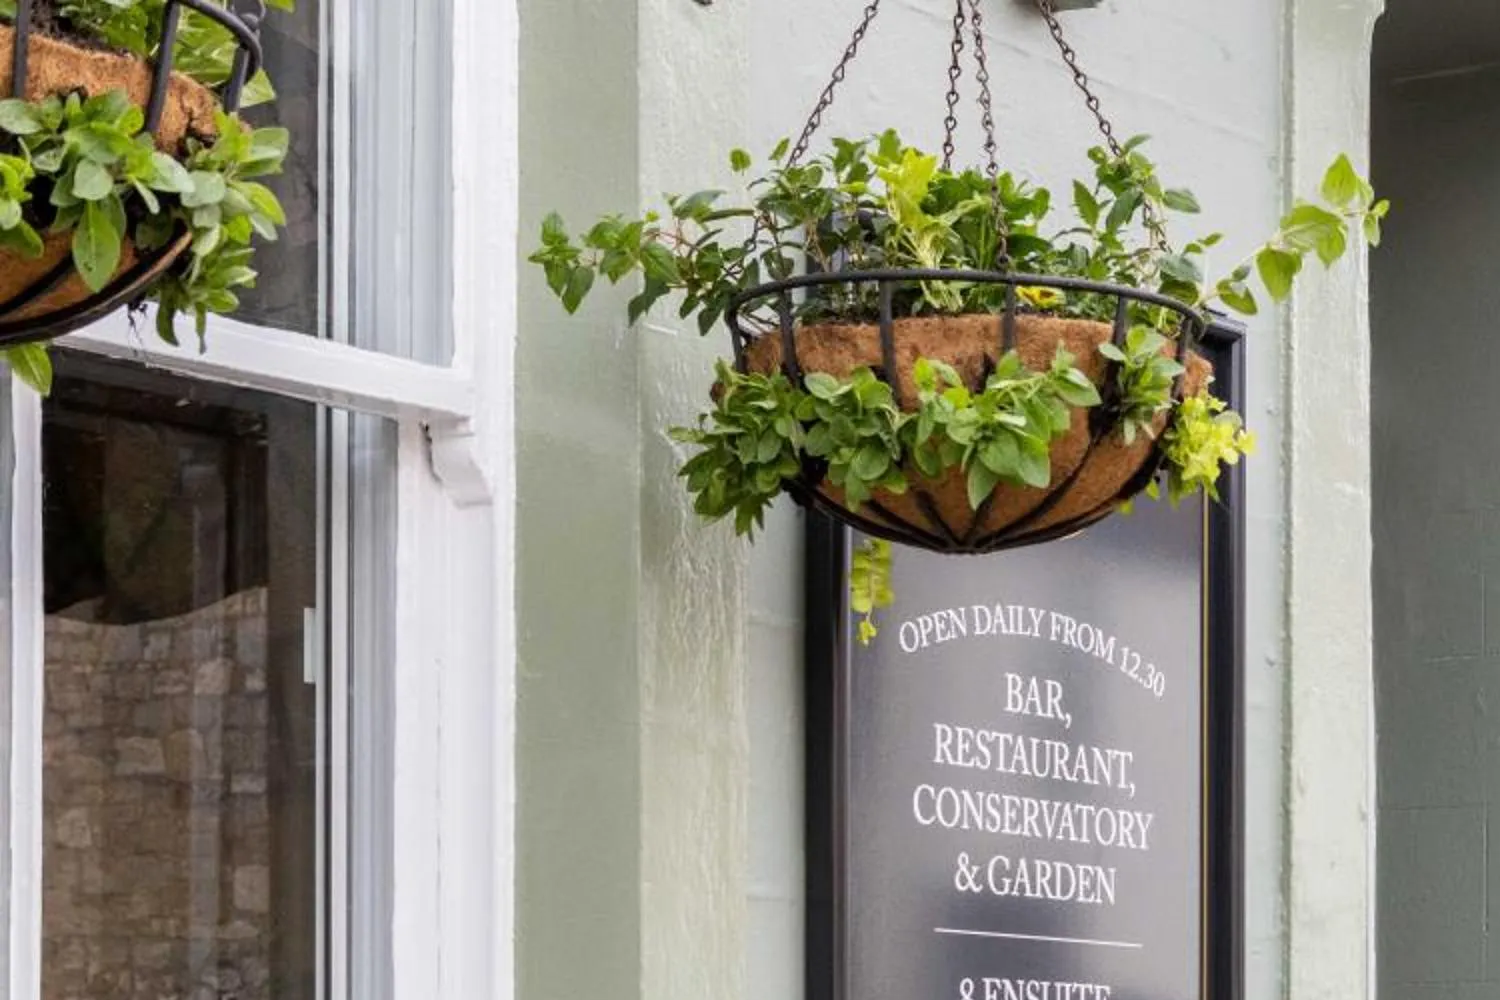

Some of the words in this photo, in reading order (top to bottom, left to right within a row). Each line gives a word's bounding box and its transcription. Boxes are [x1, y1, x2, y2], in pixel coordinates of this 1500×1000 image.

[900, 607, 968, 653] OPEN
[973, 603, 1046, 638] DAILY
[1049, 611, 1117, 666] FROM
[1119, 646, 1166, 698] 12.30
[1004, 672, 1072, 728] BAR,
[933, 722, 1136, 798] RESTAURANT,
[912, 784, 1154, 851] CONSERVATORY
[954, 852, 983, 892] &
[987, 854, 1116, 906] GARDEN
